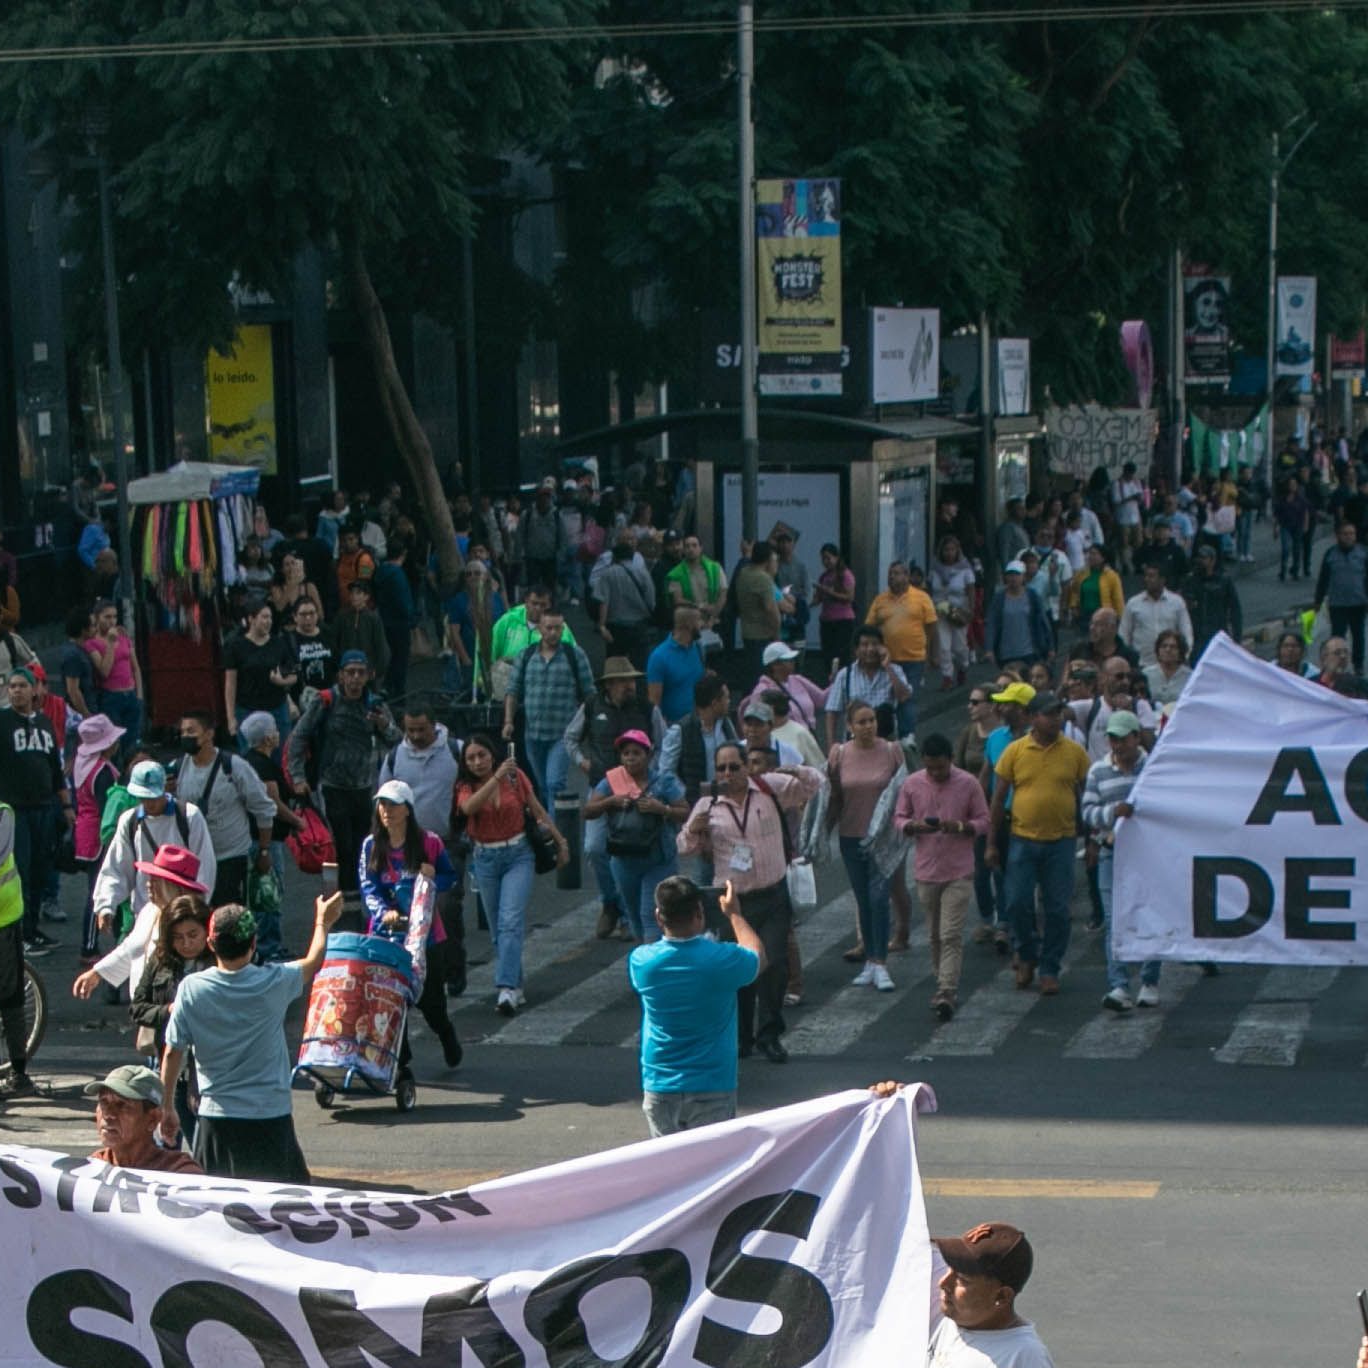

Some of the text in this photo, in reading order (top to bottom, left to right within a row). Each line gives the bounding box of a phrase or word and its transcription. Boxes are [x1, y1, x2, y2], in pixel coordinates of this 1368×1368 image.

[782, 274, 814, 289] FEST
[13, 727, 55, 754] GAP
[1192, 857, 1357, 942] DE
